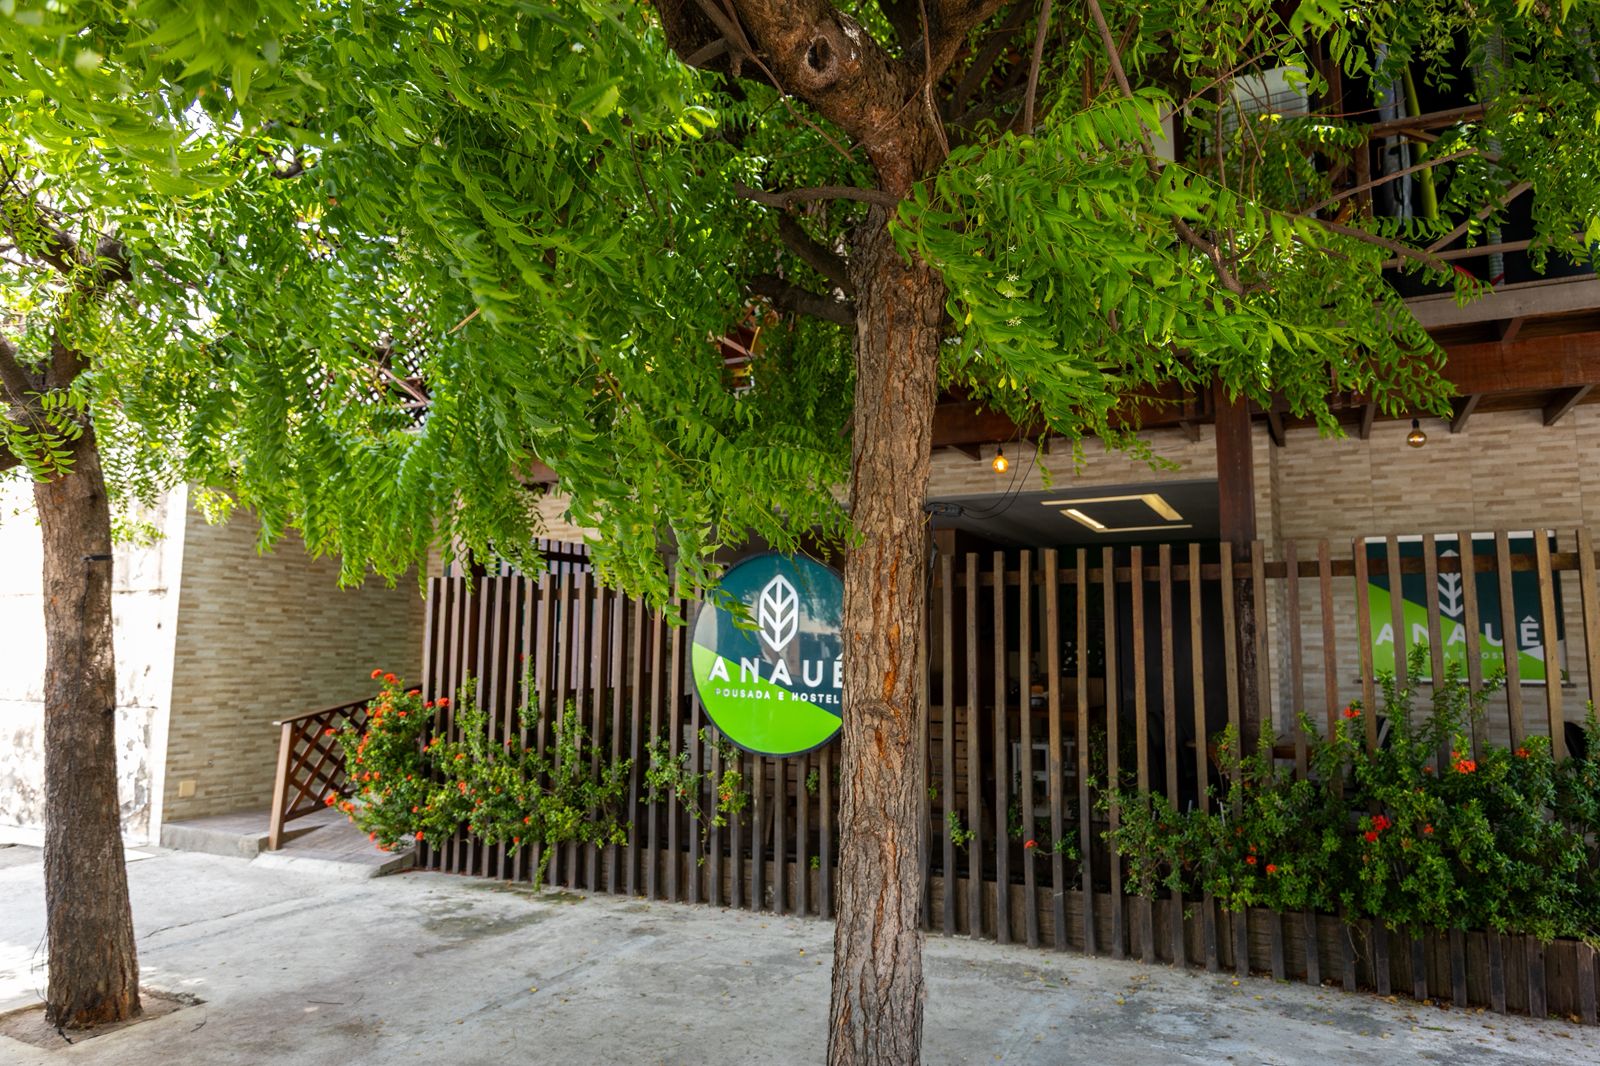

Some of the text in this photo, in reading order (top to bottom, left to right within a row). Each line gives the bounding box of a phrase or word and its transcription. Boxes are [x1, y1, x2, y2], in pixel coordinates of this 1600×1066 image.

[714, 687, 840, 704] POUSADA E HOSTEL
